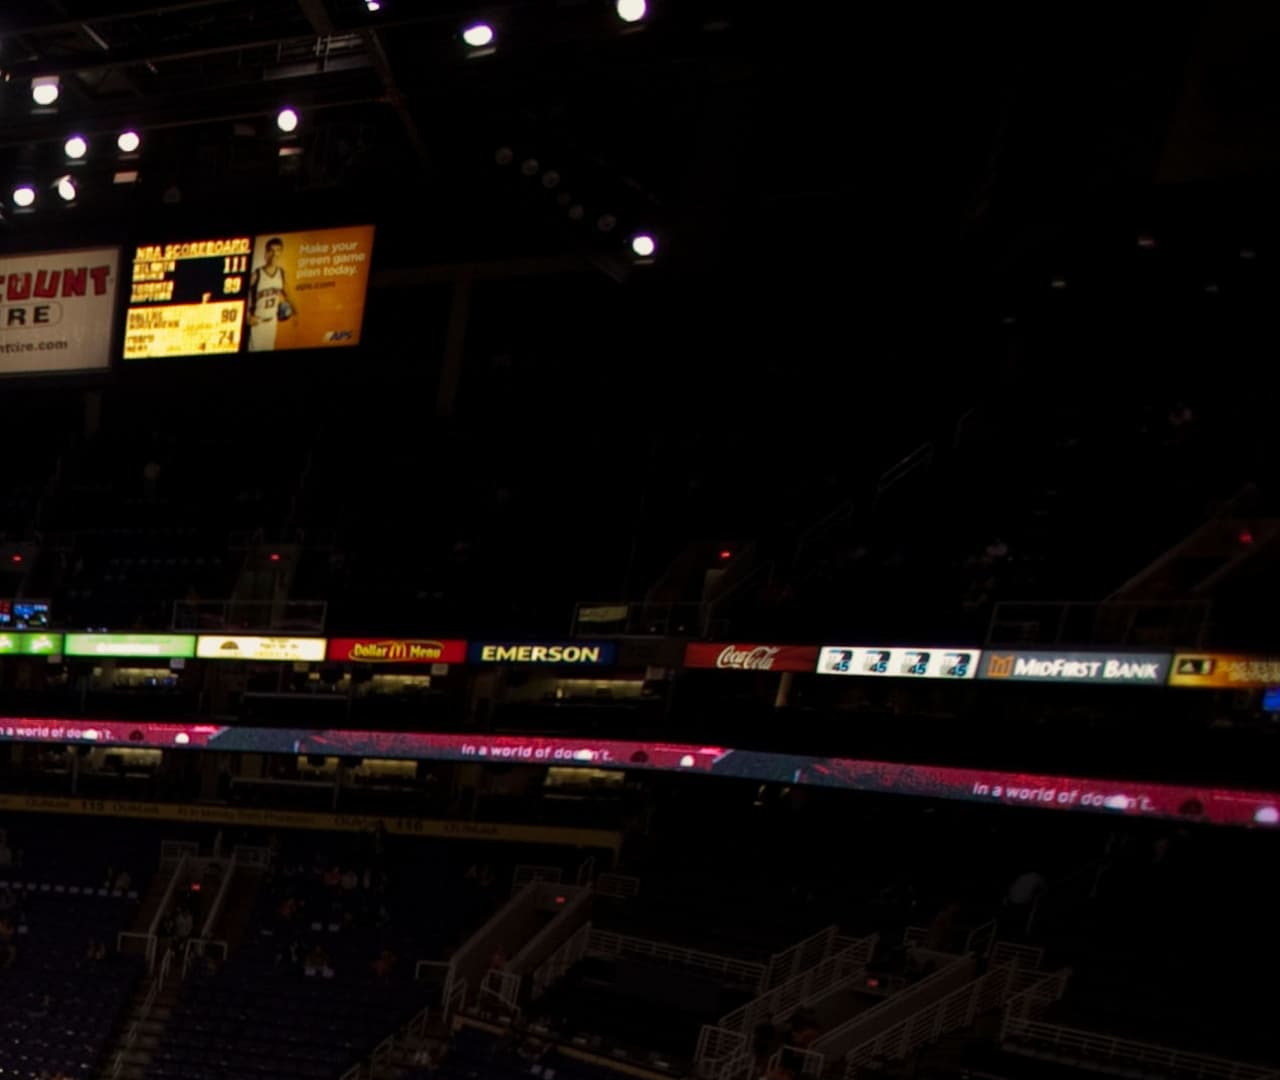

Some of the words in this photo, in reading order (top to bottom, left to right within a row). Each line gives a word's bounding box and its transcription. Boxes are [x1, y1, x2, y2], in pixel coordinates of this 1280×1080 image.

[135, 246, 162, 262] NBA
[164, 238, 251, 260] SCOREBOARD
[300, 244, 329, 254] Make
[331, 241, 359, 254] your
[223, 255, 248, 275] 111
[297, 256, 331, 268] green
[333, 253, 365, 266] game
[296, 268, 320, 280] plan
[221, 307, 238, 324] 90
[219, 330, 235, 345] 74
[354, 643, 389, 657] Dollar
[409, 645, 442, 659] Menu
[480, 645, 600, 663] EMERSON
[16, 726, 49, 737] world
[51, 726, 64, 738] of
[66, 728, 115, 740] don't.
[461, 743, 476, 755] In
[491, 745, 532, 758] world
[535, 746, 551, 759] of
[554, 747, 614, 762] don't.
[972, 781, 989, 796] In
[1006, 785, 1056, 802] world
[1057, 788, 1079, 804] of
[1080, 792, 1156, 812] don't.
